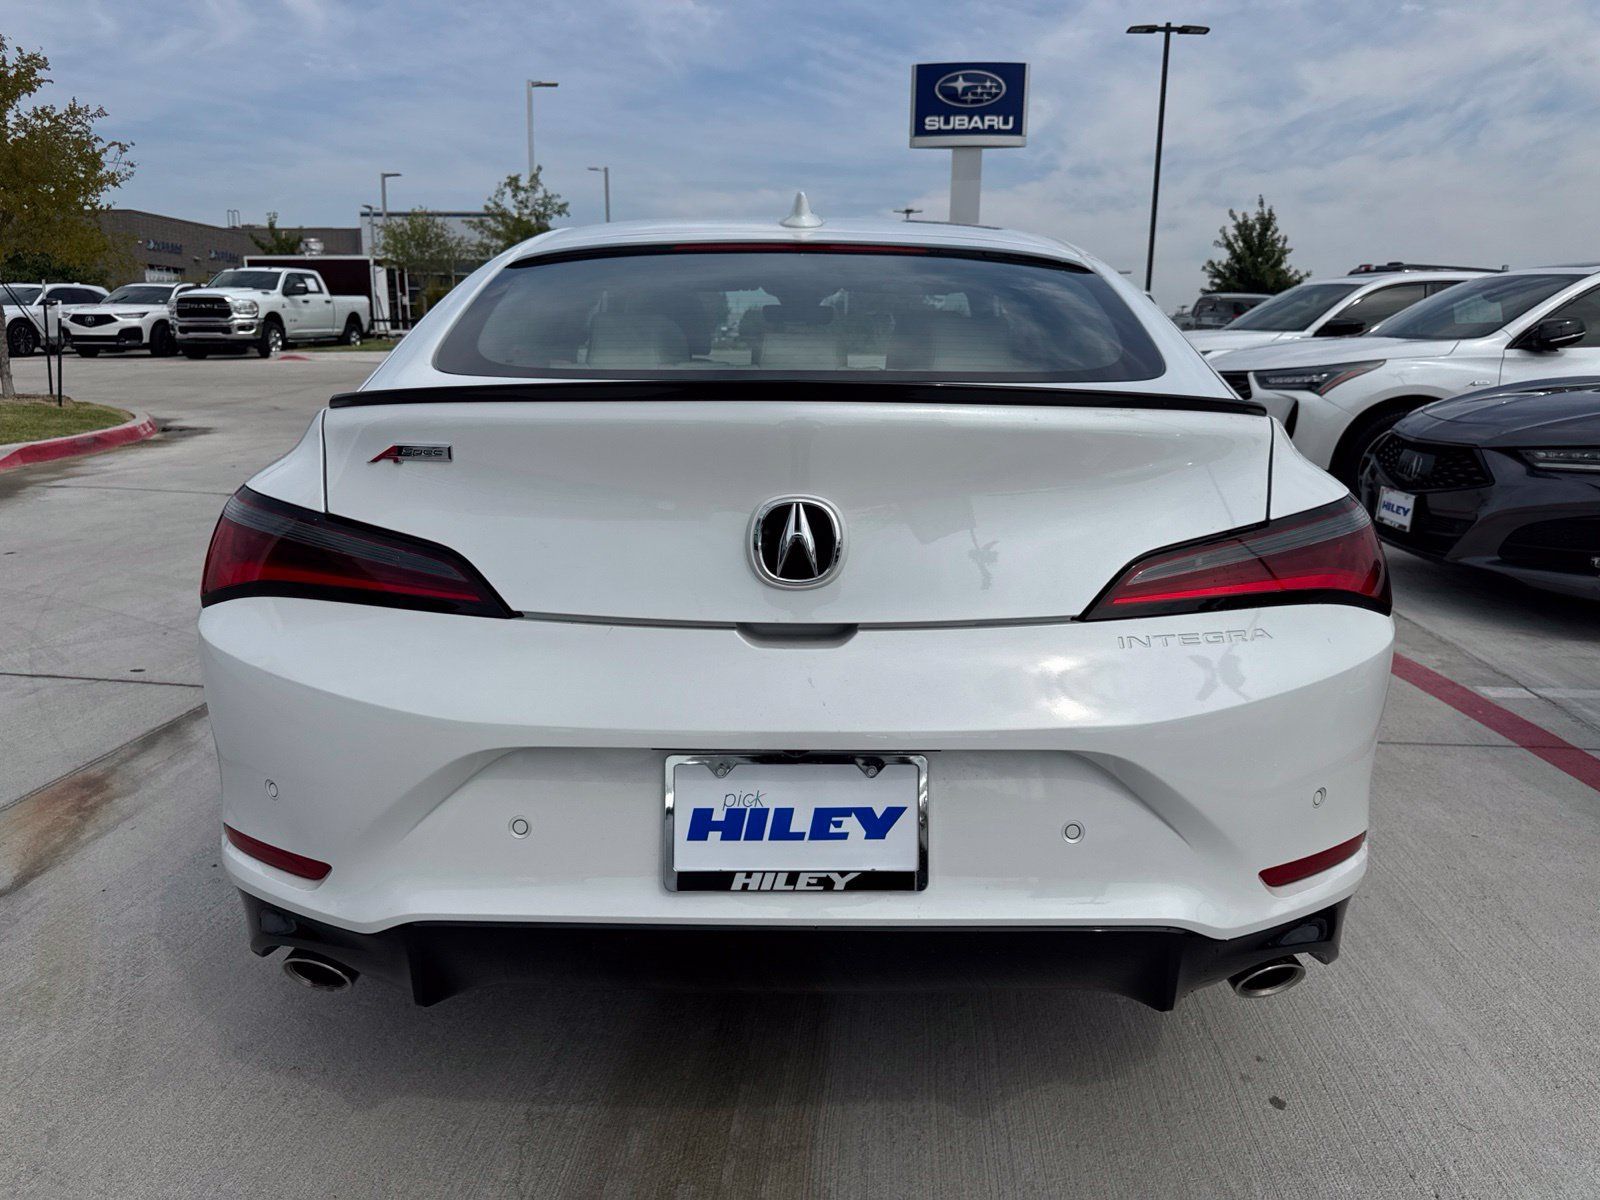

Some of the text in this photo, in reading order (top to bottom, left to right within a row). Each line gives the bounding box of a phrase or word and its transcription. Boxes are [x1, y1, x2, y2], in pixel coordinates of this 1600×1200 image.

[924, 115, 1014, 130] SUBARU
[1382, 500, 1411, 517] HILEY
[1118, 628, 1274, 649] INTEGRA
[722, 790, 767, 811] pick
[686, 806, 908, 841] HILEY
[730, 872, 862, 891] HILEY
